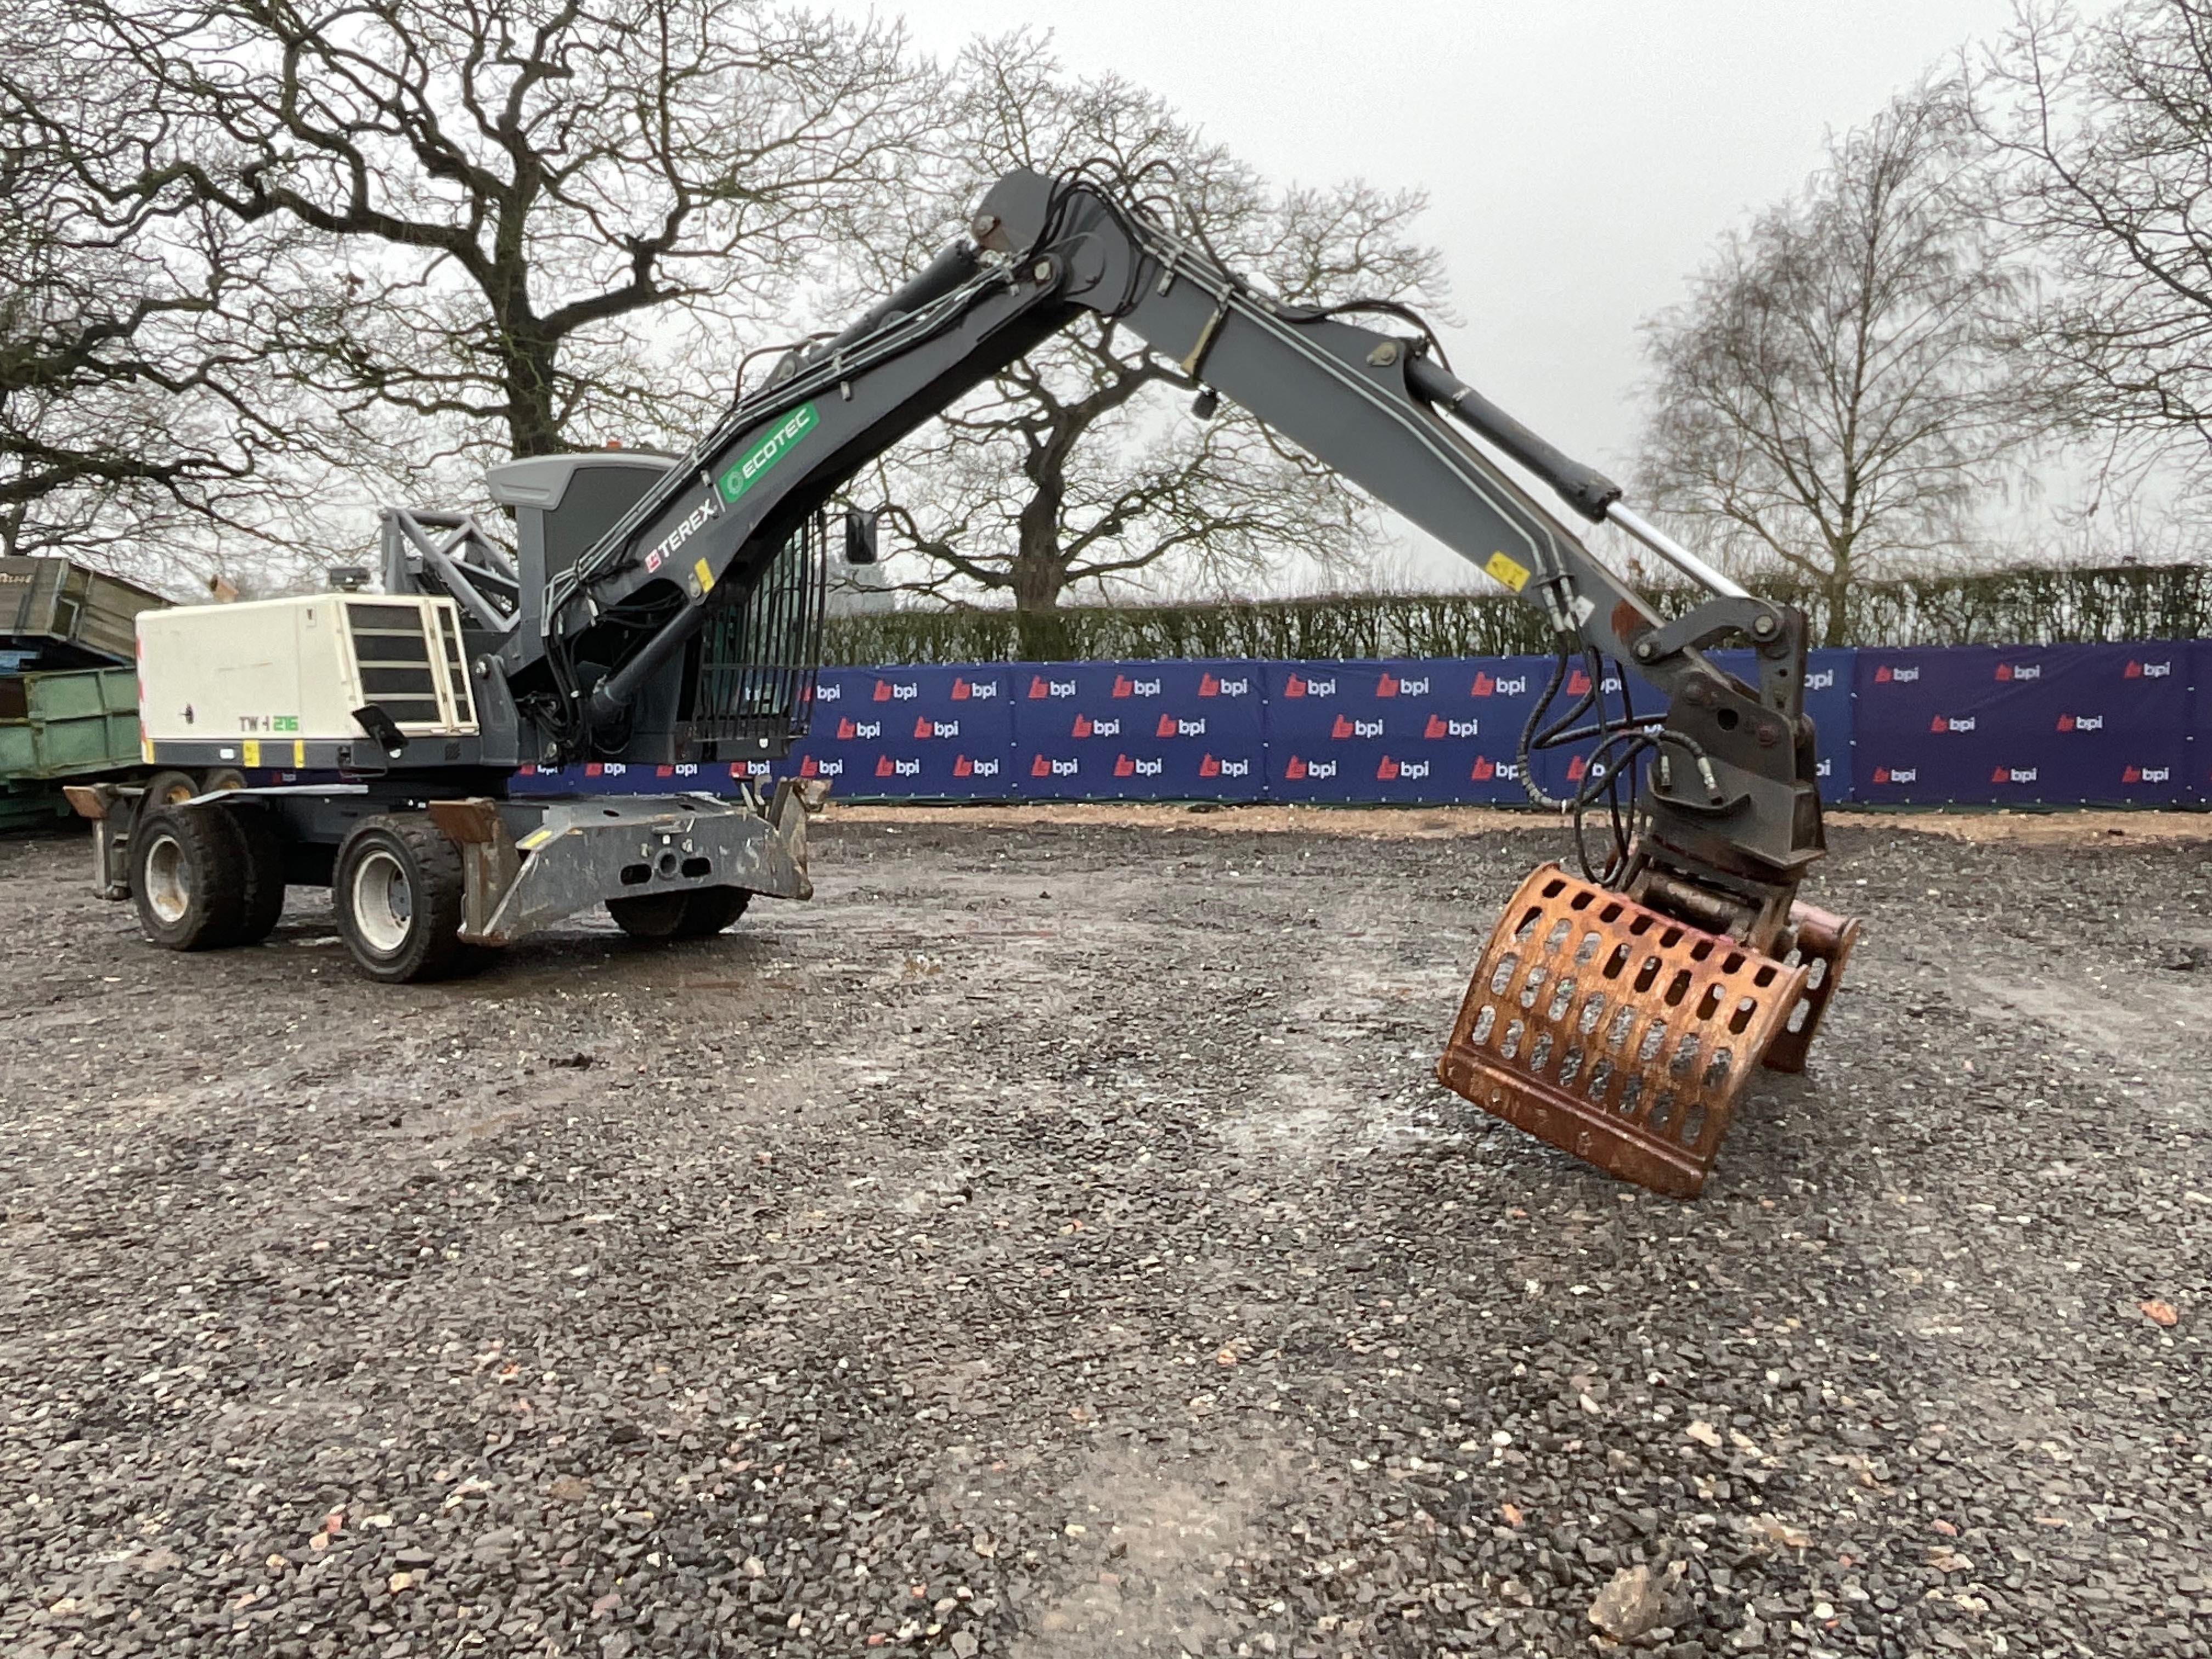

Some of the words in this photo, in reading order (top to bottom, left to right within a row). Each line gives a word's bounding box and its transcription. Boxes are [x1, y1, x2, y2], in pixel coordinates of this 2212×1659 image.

[741, 407, 811, 479] ECOTEC
[658, 498, 715, 559] TEREX
[1894, 667, 1919, 682] bpi
[2015, 665, 2040, 680] bpi
[2144, 662, 2170, 677] bpi
[816, 684, 840, 702] bpi
[893, 682, 917, 700] bpi
[971, 681, 996, 700] bpi
[1050, 680, 1075, 698] bpi
[1133, 678, 1161, 697] bpi
[1220, 678, 1248, 697] bpi
[1308, 678, 1335, 698] bpi
[1400, 677, 1429, 697] bpi
[1496, 676, 1525, 696] bpi
[1600, 678, 1622, 694] pi
[857, 721, 880, 740] bpi
[934, 720, 959, 738] bpi
[1093, 719, 1119, 737] bpi
[1178, 718, 1205, 736] bpi
[1355, 719, 1383, 738] bpi
[1448, 719, 1478, 737] bpi
[1950, 716, 1975, 732] bpi
[2076, 715, 2102, 731] bpi
[748, 760, 770, 775] bpi
[819, 759, 843, 776] bpi
[895, 758, 919, 777] bpi
[974, 758, 998, 777] bpi
[1052, 758, 1077, 777] bpi
[1136, 758, 1162, 777] bpi
[1221, 759, 1248, 777] bpi
[1308, 760, 1336, 779] bpi
[1400, 760, 1429, 779] bpi
[1496, 761, 1519, 780] bp
[1891, 769, 1916, 783] bpi
[2011, 768, 2036, 783] bpi
[2142, 767, 2169, 782] bpi
